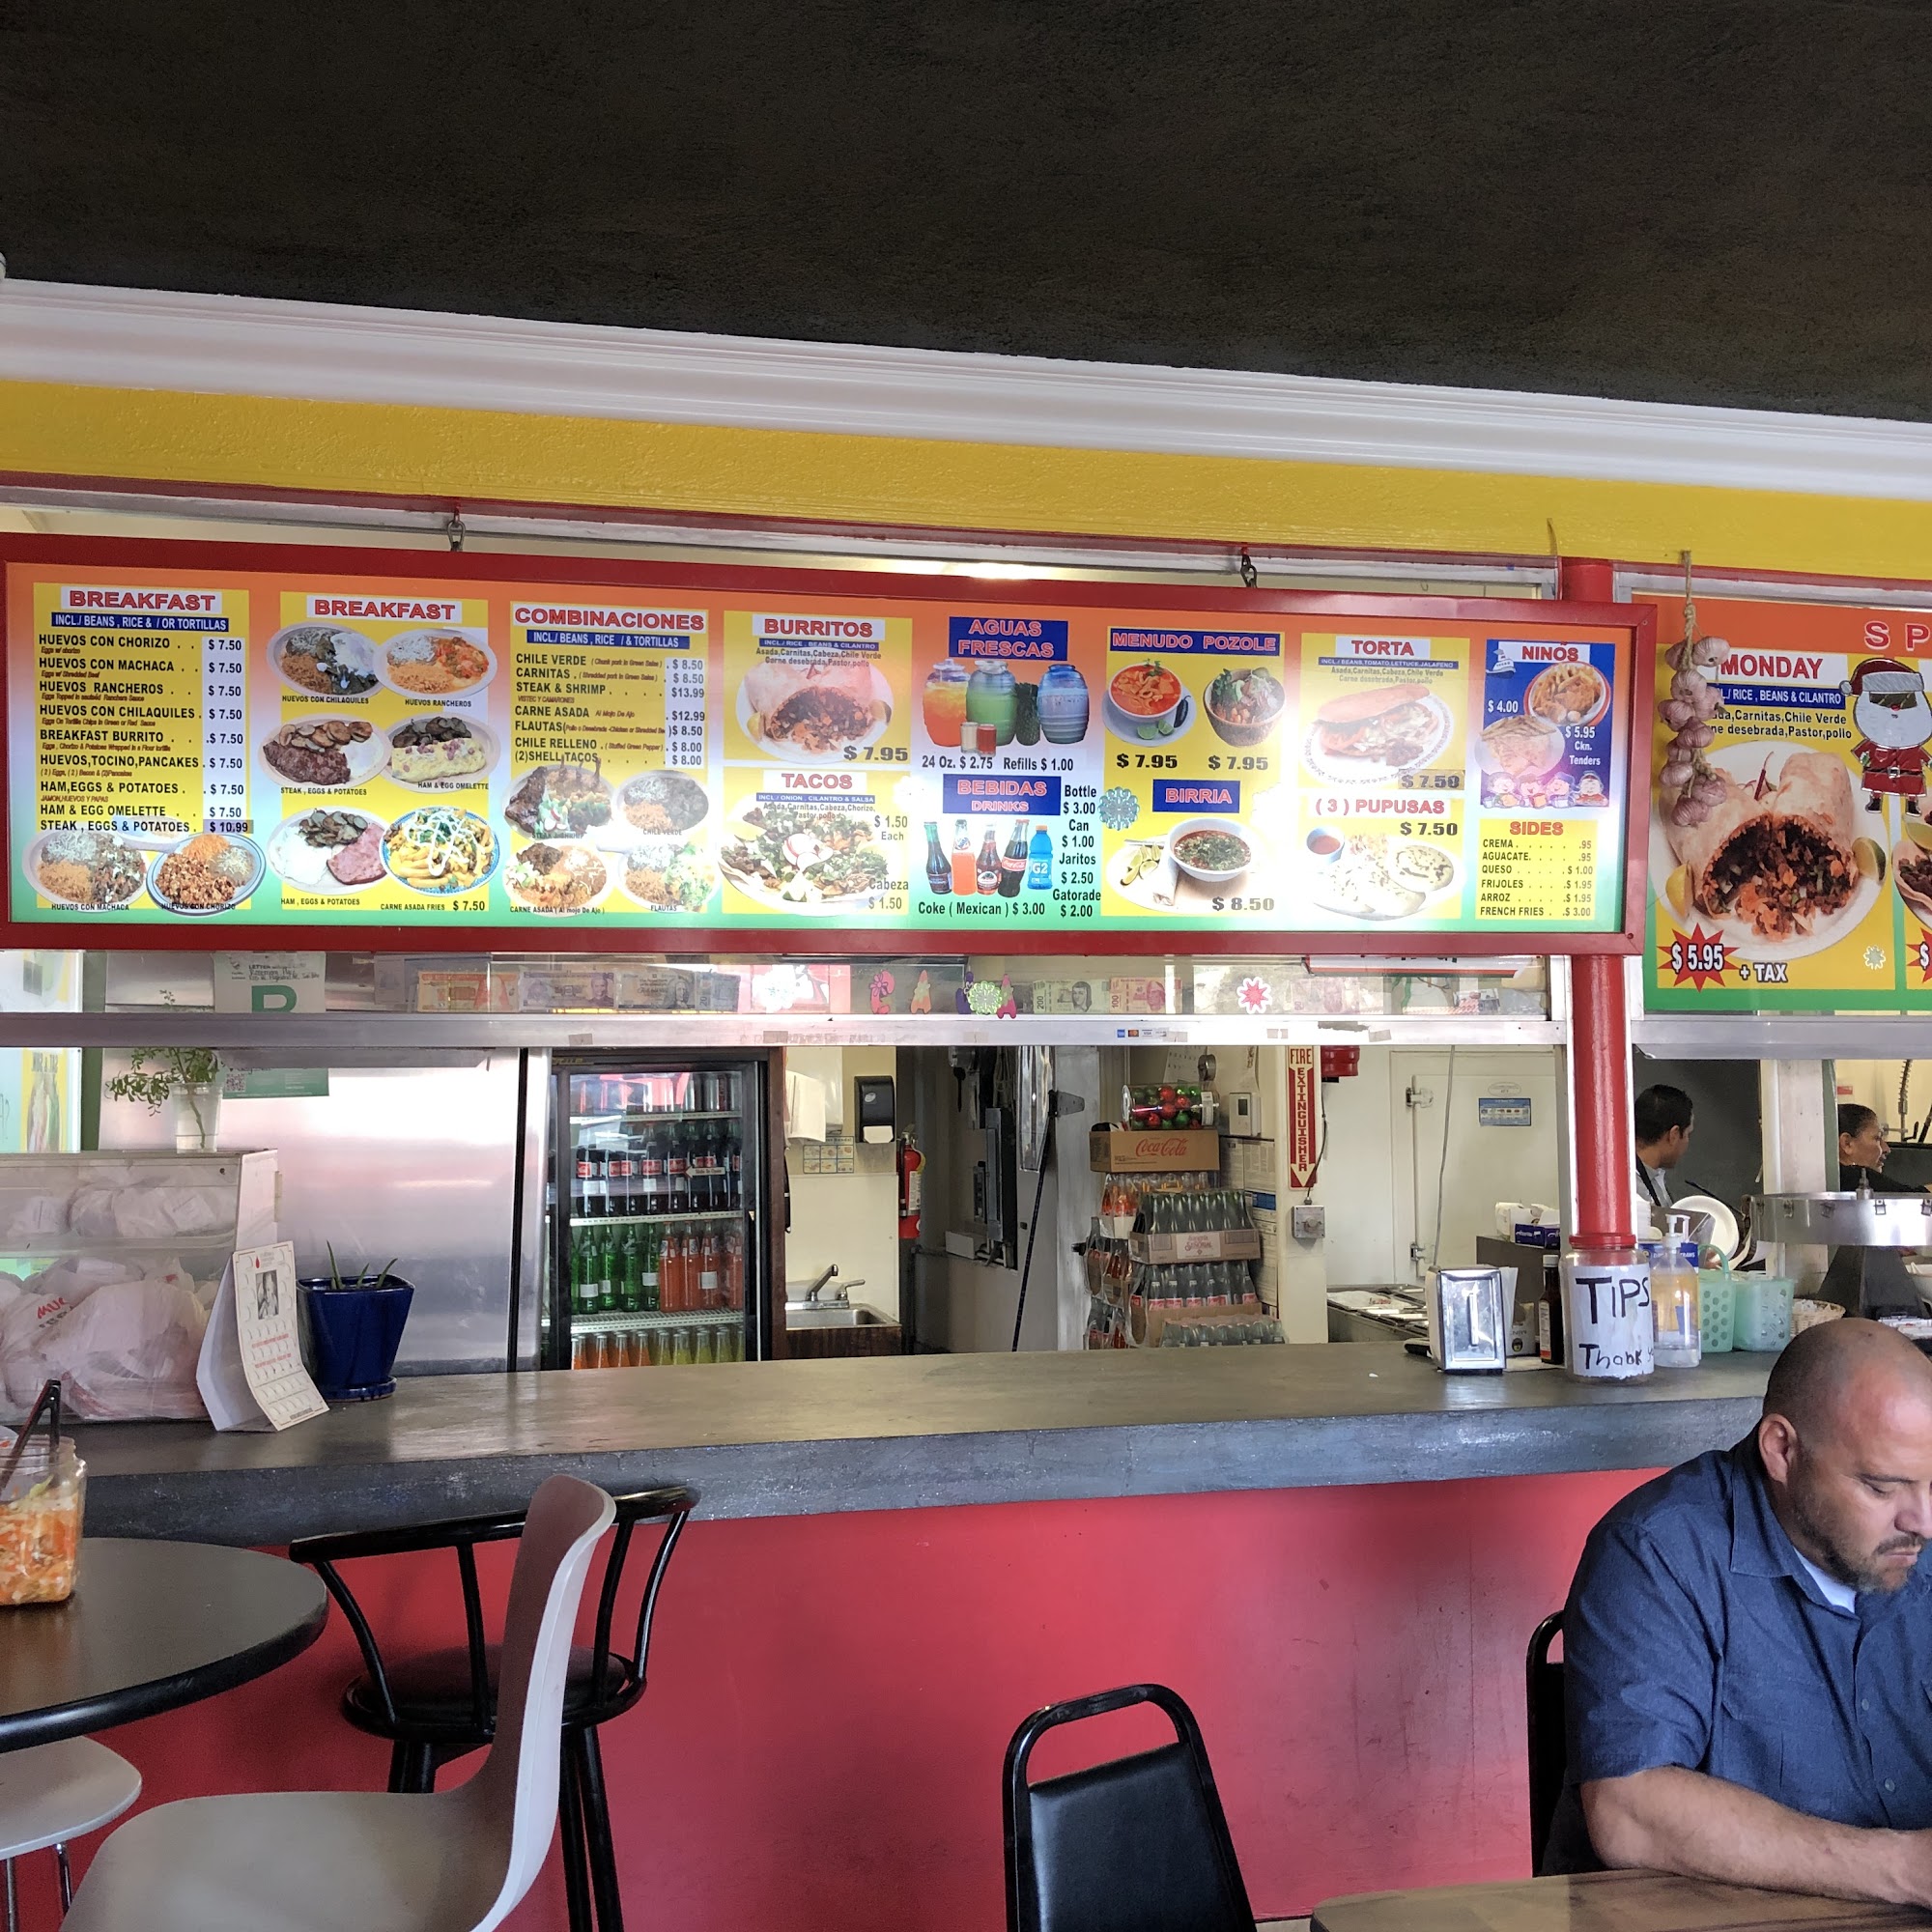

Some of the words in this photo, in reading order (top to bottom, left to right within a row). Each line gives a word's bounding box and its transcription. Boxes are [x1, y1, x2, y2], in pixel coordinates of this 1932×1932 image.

[70, 590, 215, 611] BREAKFAST
[315, 599, 455, 619] BREAKFAST
[122, 618, 143, 628] RICE
[162, 619, 175, 629] OR
[178, 619, 226, 630] TORTILLAS
[515, 608, 704, 631] COMBINACIONES
[764, 618, 872, 638] BURRITOS
[969, 619, 1042, 637] AGUAS
[40, 635, 86, 646] HUEVOS
[91, 636, 114, 647] CON
[119, 637, 170, 648] CHORIZO
[595, 635, 614, 645] RICE
[634, 636, 679, 647] TORTILLAS
[1112, 633, 1193, 649] MENUDO
[1204, 636, 1276, 651] POZOLE
[1351, 639, 1414, 656] TORTA
[958, 640, 1054, 658] FRESCAS
[40, 658, 86, 668] HUEVOS
[91, 659, 114, 670] CON
[118, 661, 174, 671] MACHACA
[517, 653, 548, 665] CHILE
[552, 655, 586, 666] VERDE
[1720, 654, 1823, 679] MONDAY
[517, 668, 570, 679] CARNITAS
[40, 681, 86, 693] HUEVOS
[94, 683, 163, 695] RANCHEROS
[517, 682, 551, 694] STEAK
[554, 683, 562, 694] &
[566, 684, 606, 696] SHRIMP
[671, 688, 704, 698] $13.99
[1734, 689, 1753, 700] RICE
[1760, 691, 1789, 702] BEANS
[1791, 692, 1798, 702] &
[1799, 692, 1841, 704] CILANTRO
[40, 704, 87, 716] HUEVOS
[91, 706, 114, 717] CON
[119, 707, 195, 719] CHILAQUILES
[515, 705, 551, 717] CARNE
[554, 706, 589, 718] ASADA
[672, 711, 705, 722] $12.99
[1818, 713, 1846, 724] Verde
[40, 729, 107, 741] BREAKFAST
[113, 731, 163, 743] BURRITO
[515, 737, 547, 749] CHILE
[550, 738, 597, 750] RELLENO
[564, 752, 598, 763] TACOS
[922, 755, 935, 768] 24
[1004, 757, 1037, 770] Refills
[1570, 754, 1601, 765] Tenders
[107, 781, 114, 792] &
[120, 782, 178, 794] POTATOES
[781, 773, 853, 789] TACOS
[957, 779, 1047, 796] BEBIDAS
[1065, 784, 1096, 798] Bottle
[1165, 788, 1233, 804] BIRRIA
[41, 804, 65, 815] HAM
[70, 805, 76, 814] &
[81, 805, 103, 815] EGG
[107, 806, 166, 816] OMELETTE
[972, 800, 1029, 811] DRINKS
[1355, 799, 1444, 814] PUPUSAS
[41, 820, 76, 831] STEAK
[88, 820, 118, 832] EGGS
[122, 821, 129, 832] &
[133, 821, 189, 833] POTATOES
[1069, 819, 1089, 831] Can
[1510, 821, 1563, 836] SIDES
[881, 832, 904, 840] Each
[1483, 839, 1513, 848] CREMA
[1059, 852, 1096, 866] Jaritos
[1032, 863, 1047, 874] G2
[869, 878, 909, 890] Cabeza
[1482, 880, 1523, 889] FRIJOLES
[1053, 889, 1101, 900] Gatorade
[919, 901, 946, 914] Coke
[956, 902, 1002, 915] Mexican
[1480, 907, 1516, 916] FRENCH
[1519, 907, 1544, 916] FRIES
[1754, 964, 1788, 982] TAX
[1291, 1048, 1312, 1065] FIRE
[1297, 1067, 1308, 1172] EXTINGUISHER
[1576, 1276, 1650, 1324] TIPS
